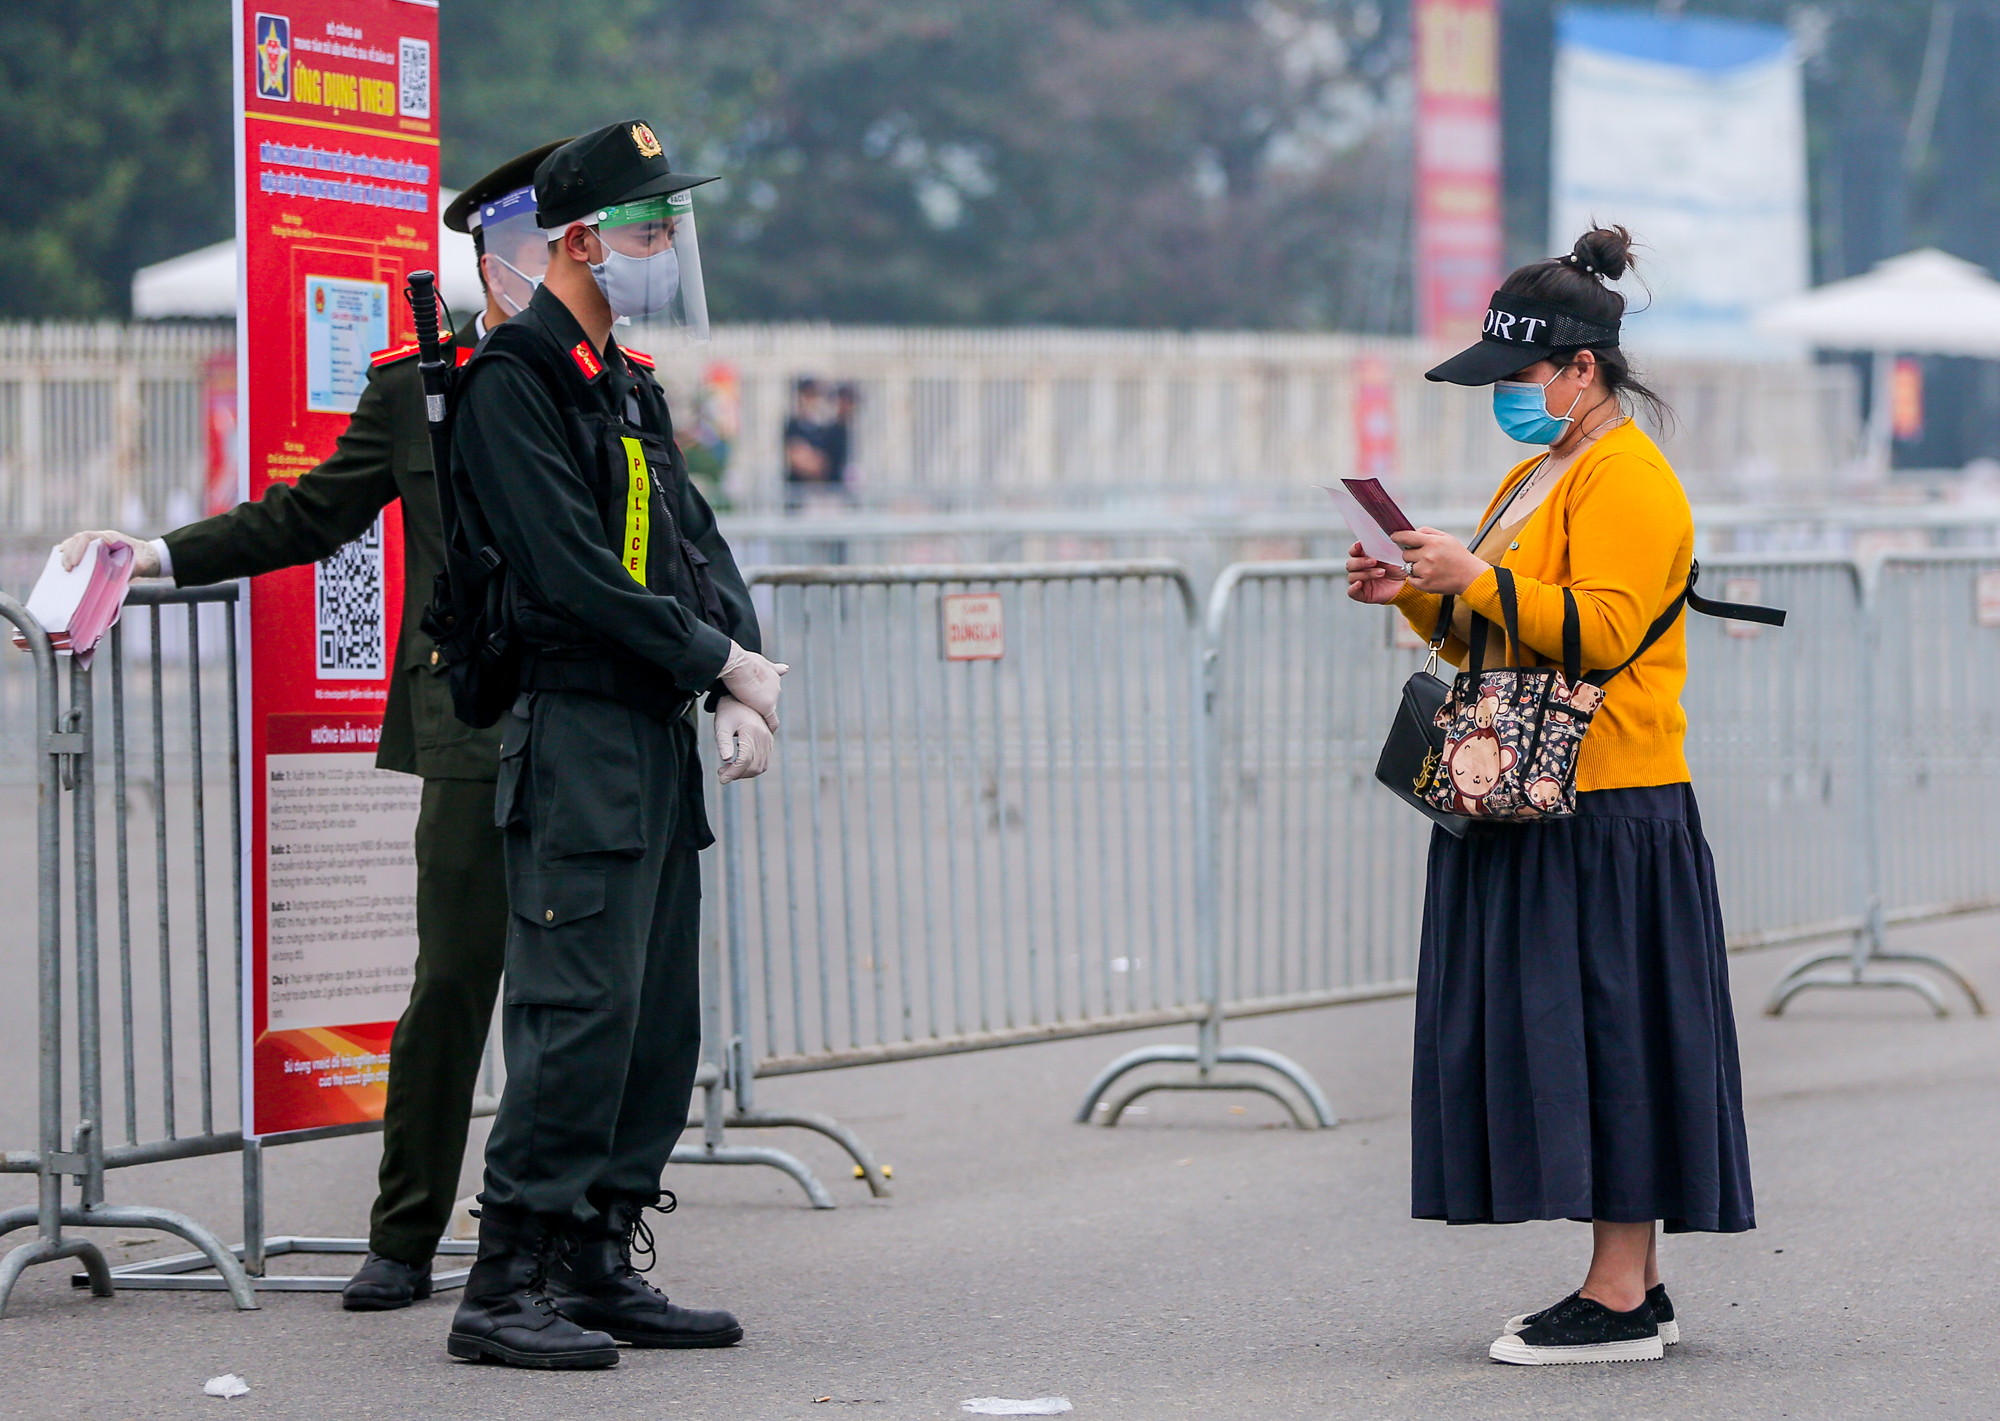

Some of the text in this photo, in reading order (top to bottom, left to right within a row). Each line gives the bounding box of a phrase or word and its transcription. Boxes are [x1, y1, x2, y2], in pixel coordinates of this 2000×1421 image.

[670, 194, 685, 204] FACE
[630, 457, 644, 571] POLICE
[311, 725, 339, 744] HƯỚNG
[340, 720, 356, 744] DẪN
[356, 724, 374, 744] VÀO
